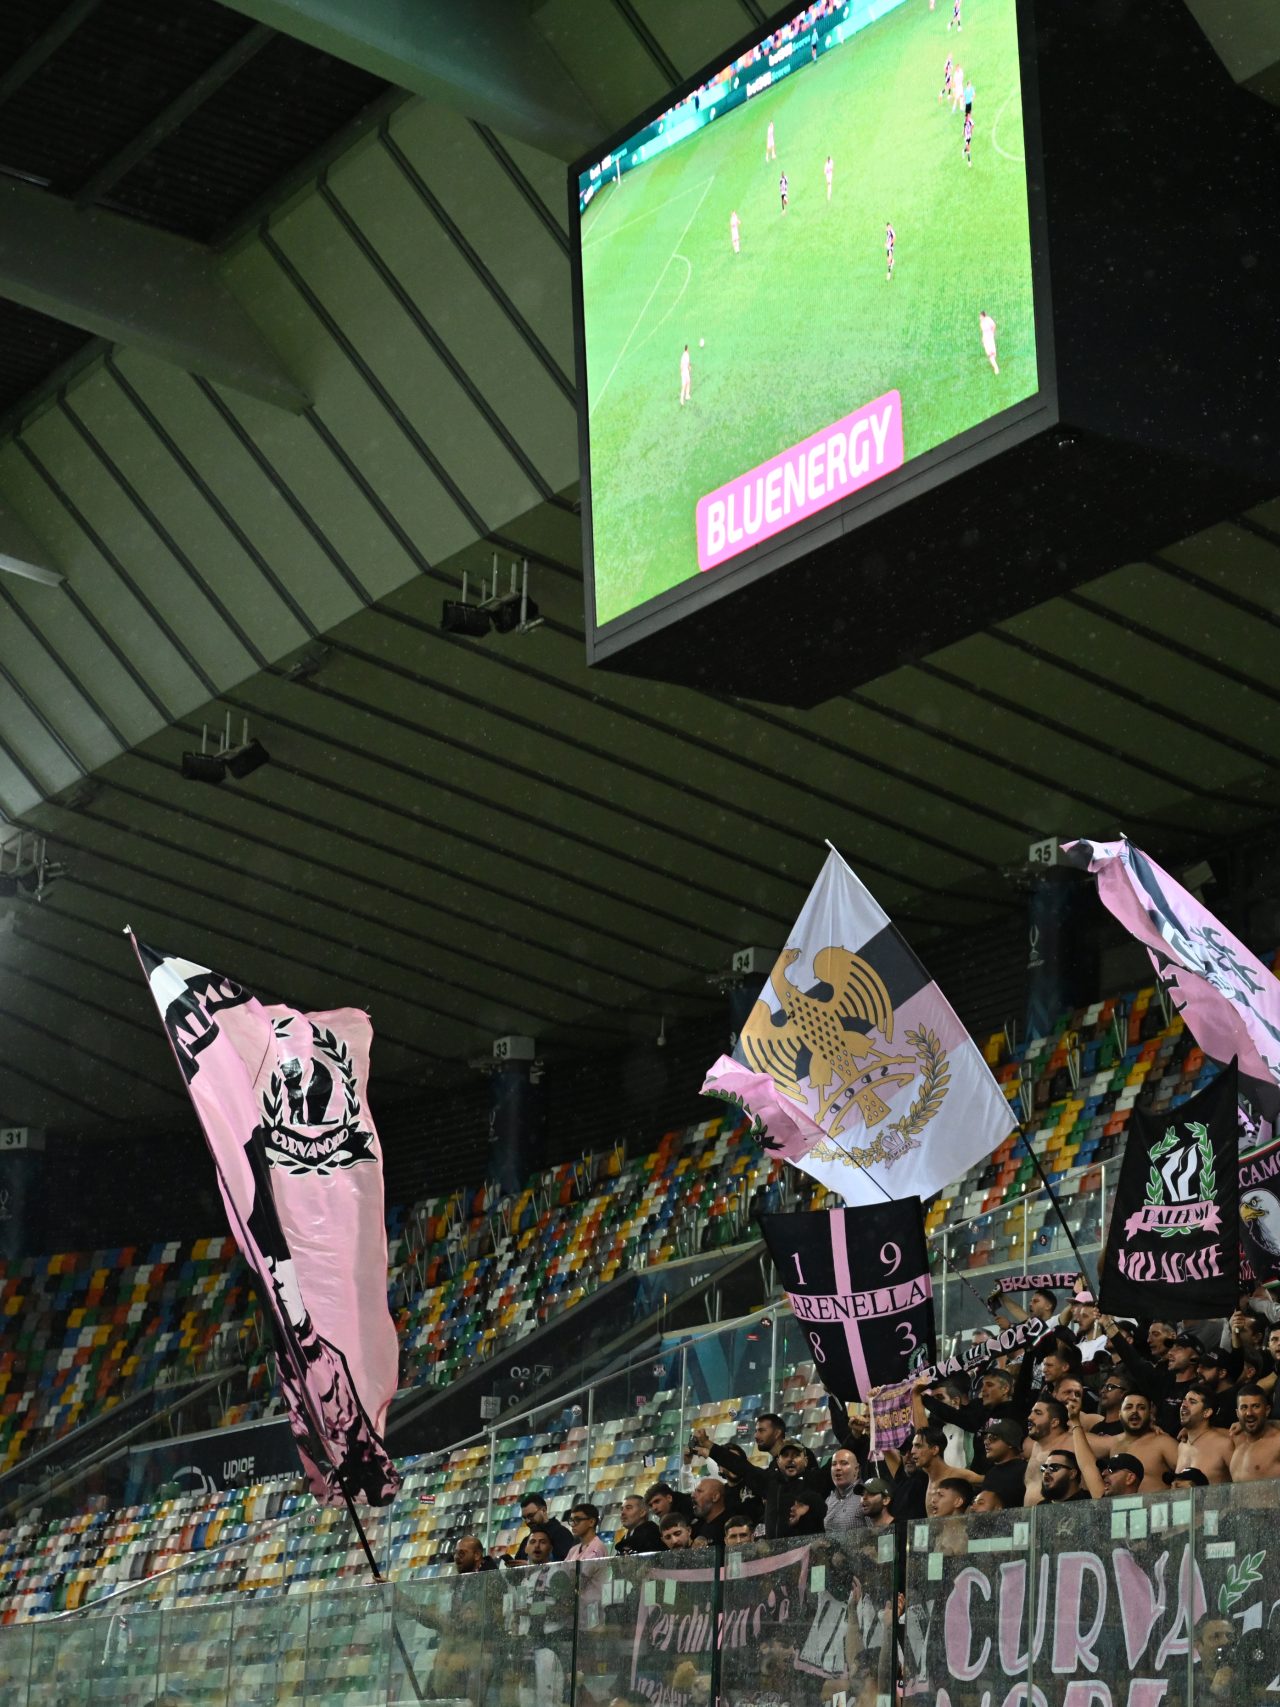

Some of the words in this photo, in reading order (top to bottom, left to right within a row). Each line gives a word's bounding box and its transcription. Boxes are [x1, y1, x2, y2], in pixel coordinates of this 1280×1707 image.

[706, 404, 893, 557] BLUENERGY
[1034, 844, 1052, 863] 35
[736, 952, 750, 972] 34
[495, 1041, 508, 1056] 33
[4, 1131, 22, 1146] 31
[1161, 1143, 1199, 1203] 12
[1000, 1272, 1079, 1294] BRIGATE
[792, 1281, 927, 1321] ARENELLA
[986, 1316, 1044, 1353] NORD
[944, 1542, 1208, 1682] CURVA
